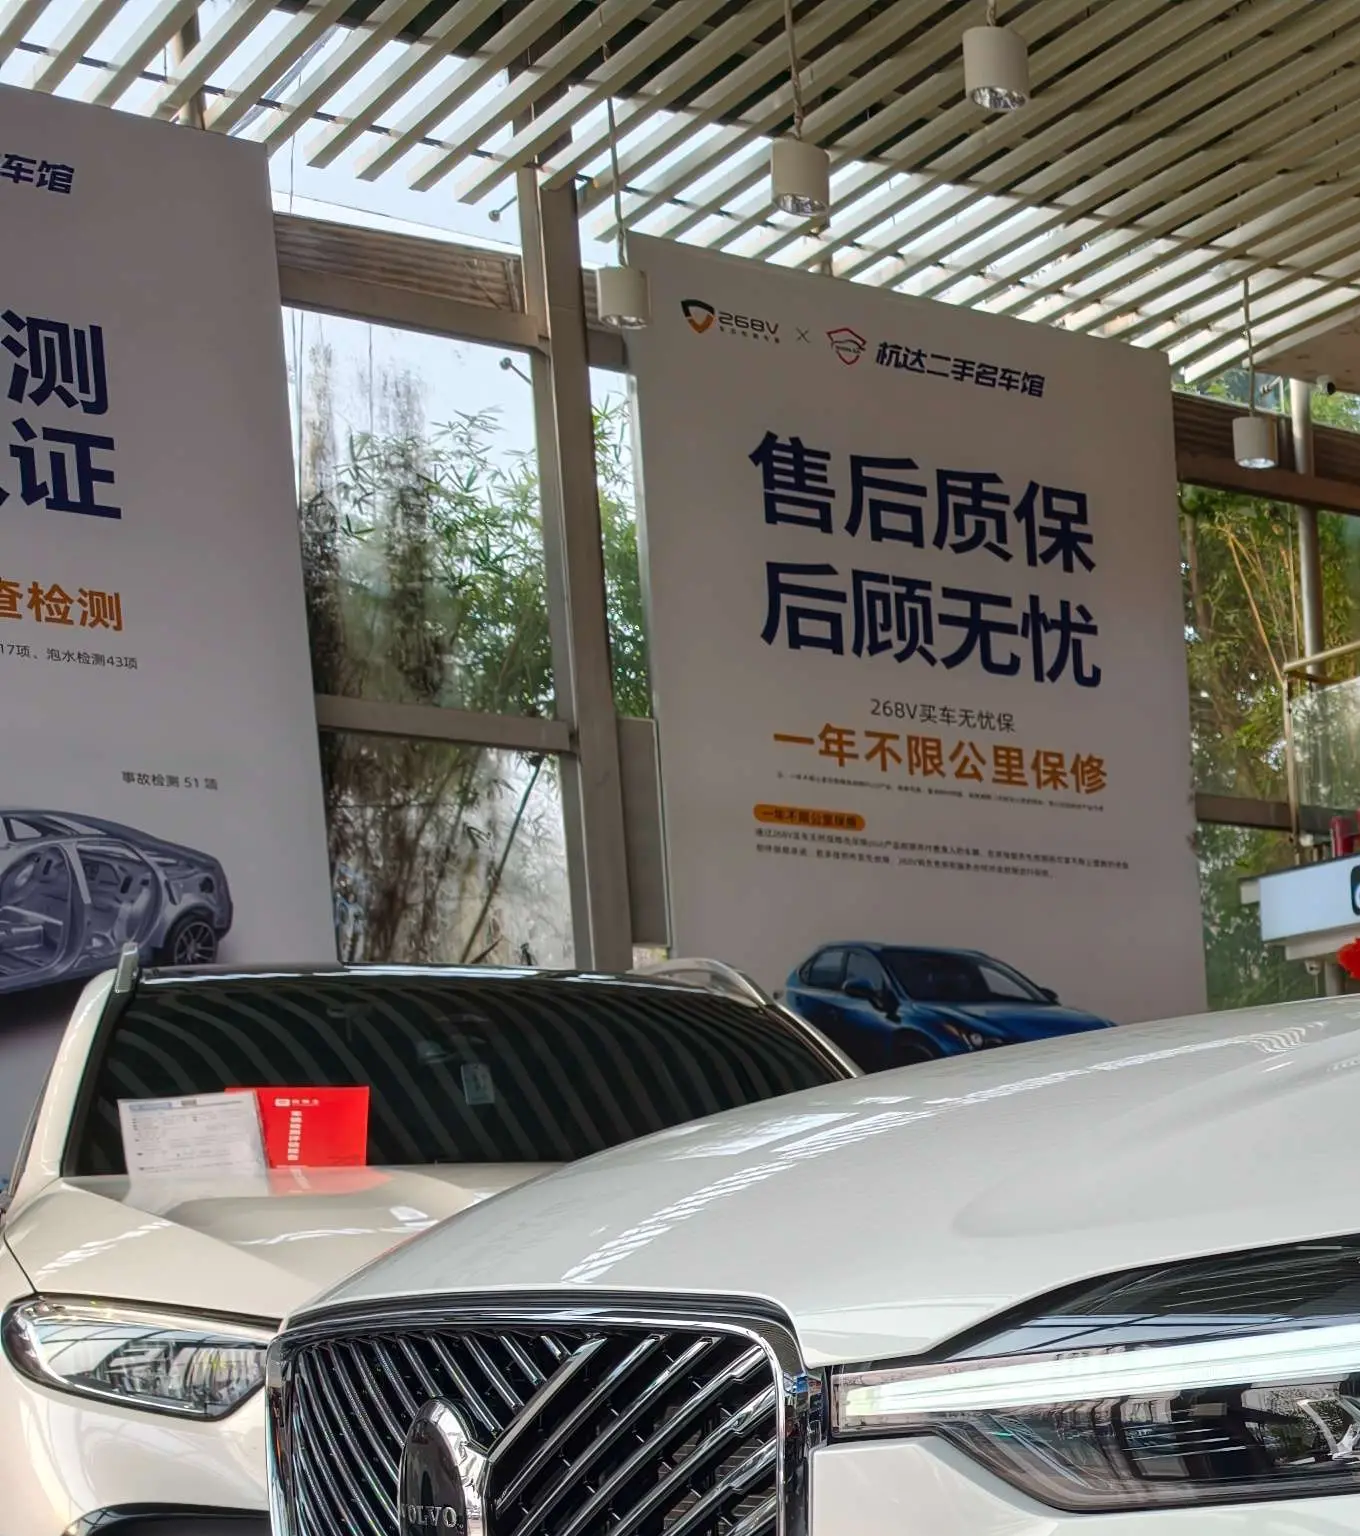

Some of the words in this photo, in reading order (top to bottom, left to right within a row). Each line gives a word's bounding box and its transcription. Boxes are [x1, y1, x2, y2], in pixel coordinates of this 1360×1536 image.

[717, 311, 780, 335] 268V
[1, 308, 110, 417] 测
[876, 341, 1045, 398] 杭达二手名车馆
[0, 417, 122, 519] 证
[749, 430, 1096, 574] 售后质保
[760, 561, 1102, 689] 后顾无忧
[870, 698, 1016, 735] 268V买车无忧保
[184, 776, 199, 788] 51
[773, 722, 1108, 795] 一年不限公里保修
[400, 1504, 457, 1528] VOLVO
